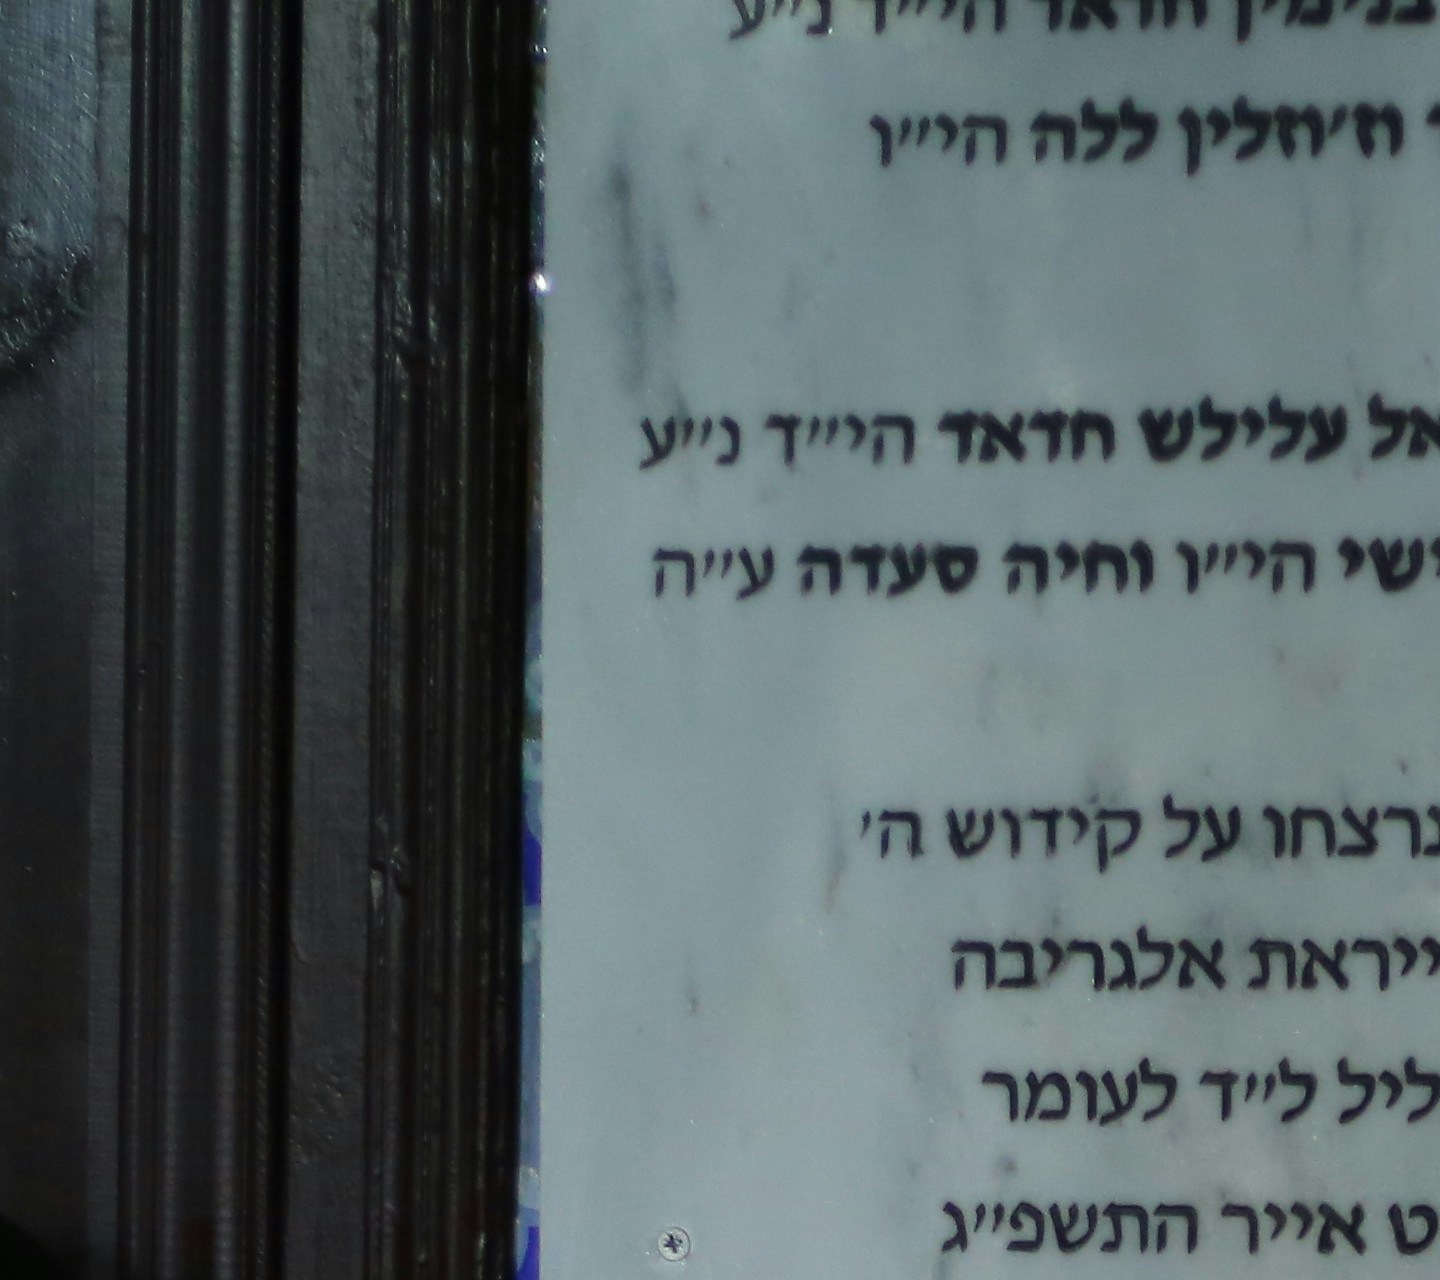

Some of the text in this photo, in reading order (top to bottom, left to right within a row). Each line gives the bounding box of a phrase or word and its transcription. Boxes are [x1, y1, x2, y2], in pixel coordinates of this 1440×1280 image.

[1029, 97, 1160, 164] ללה
[936, 408, 1117, 464] חדאד
[1136, 393, 1349, 464] עלילש
[796, 541, 980, 598] סעדה
[1001, 538, 1156, 595] וחיה
[944, 805, 1143, 874] קידוש
[1161, 792, 1243, 864] על
[949, 928, 1228, 993] אלגריבה
[980, 1058, 1179, 1128] לעומר
[1219, 1200, 1368, 1257] אייר
